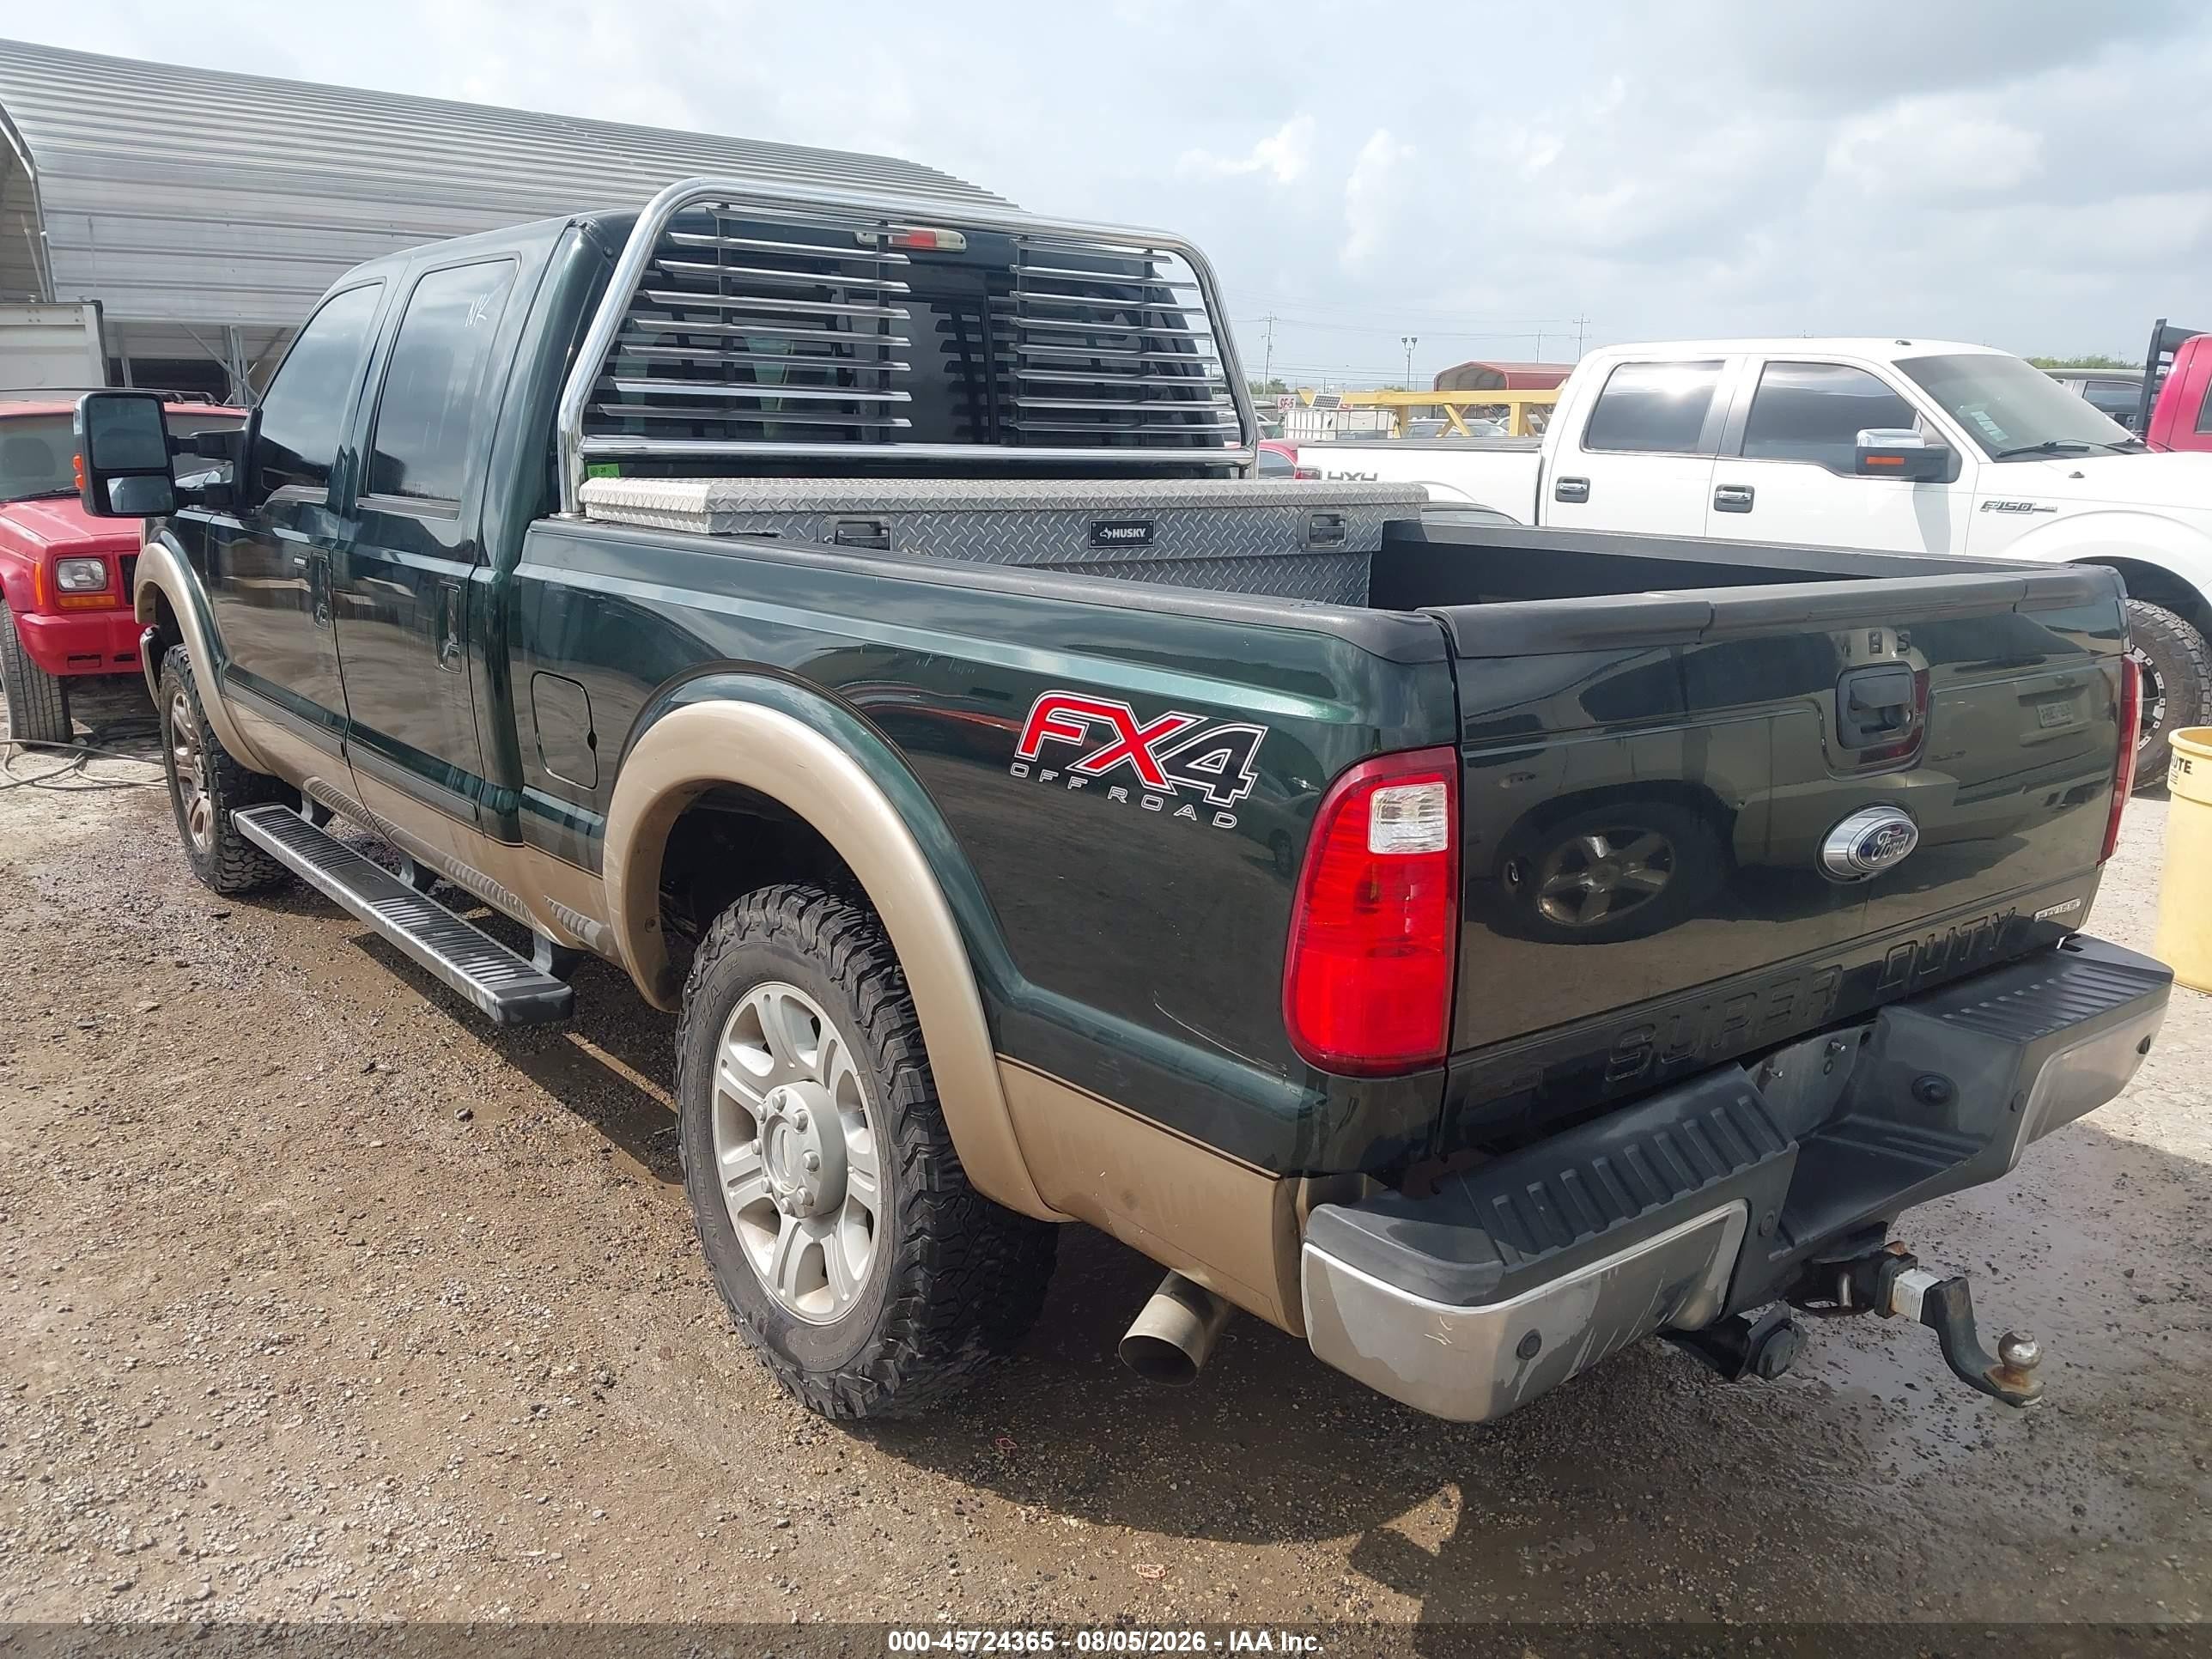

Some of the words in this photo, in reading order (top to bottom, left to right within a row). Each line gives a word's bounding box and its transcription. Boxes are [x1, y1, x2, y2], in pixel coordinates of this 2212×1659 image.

[1279, 398, 1295, 410] SF-5
[1112, 528, 1146, 538] HUSKY
[1014, 690, 1269, 807] FX4
[1010, 761, 1089, 790] OFF
[1106, 786, 1238, 829] ROAD
[1871, 830, 1911, 861] Ford
[1605, 963, 1843, 1083] SUPER
[1877, 907, 2016, 999] DUTY
